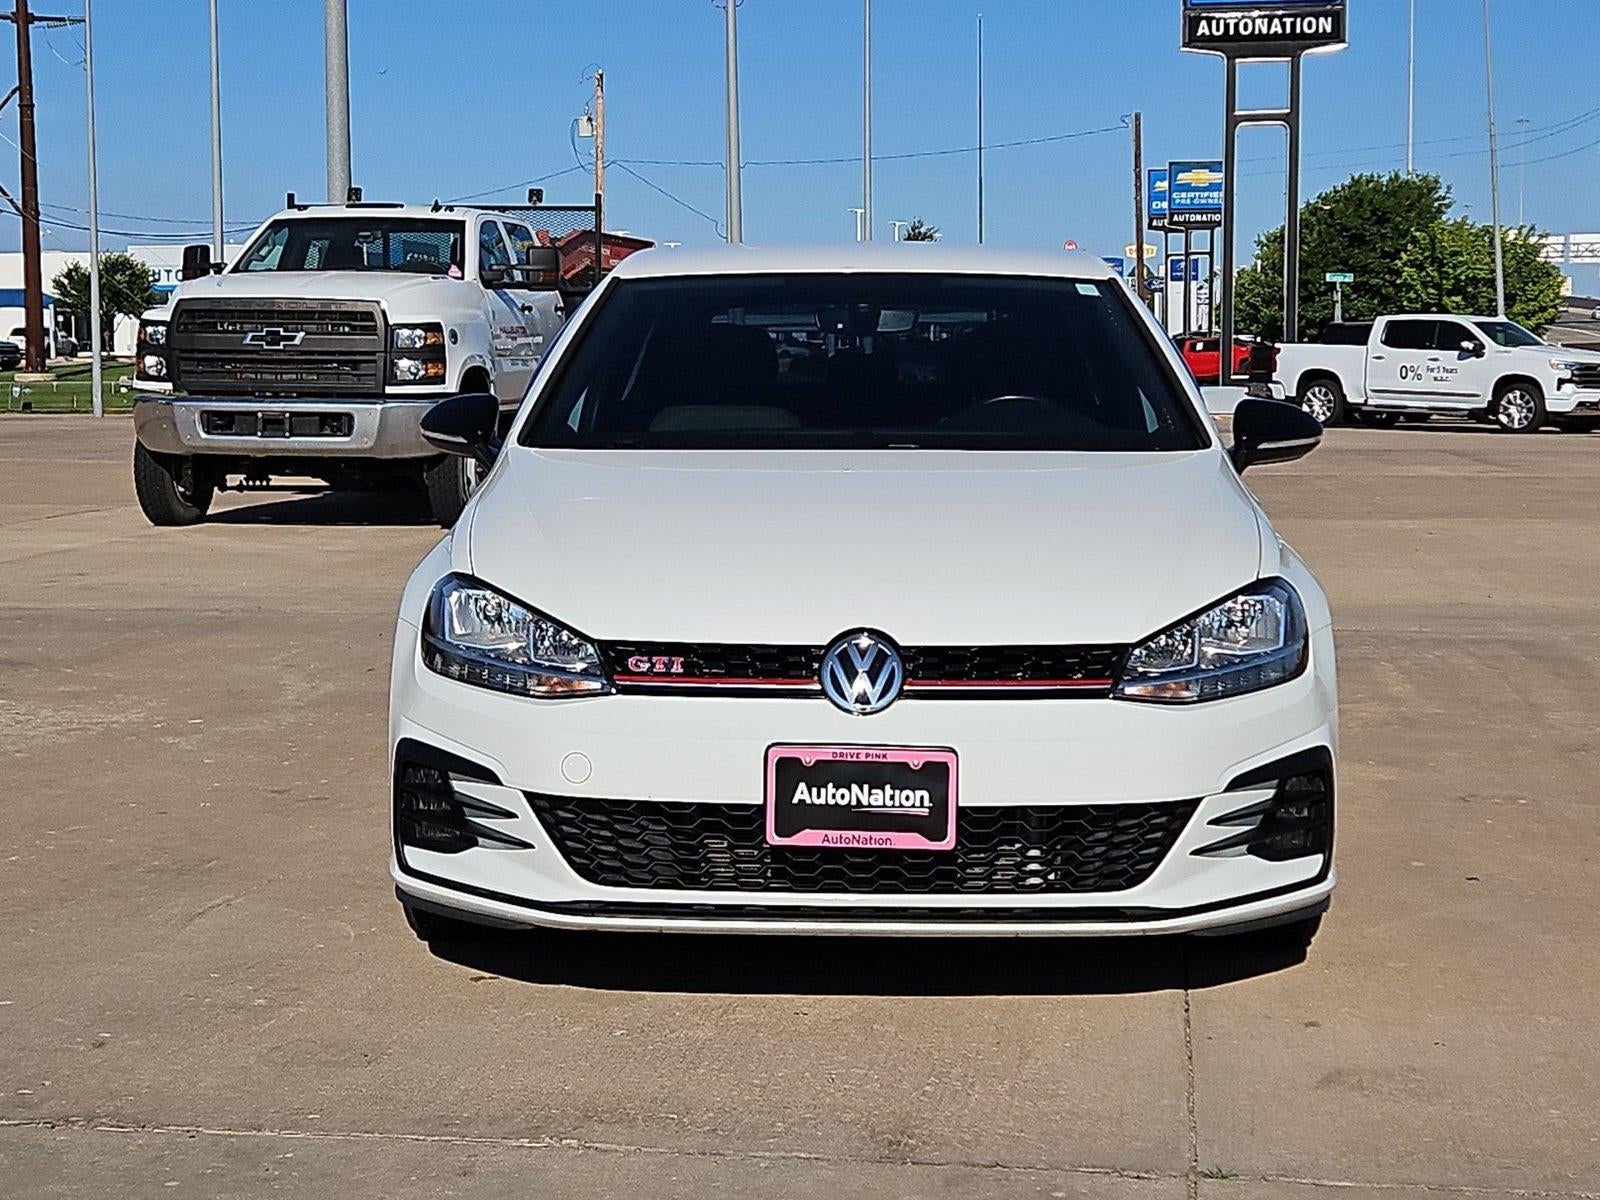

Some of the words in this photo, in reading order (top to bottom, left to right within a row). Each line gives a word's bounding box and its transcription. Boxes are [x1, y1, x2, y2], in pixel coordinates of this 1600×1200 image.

[1197, 17, 1333, 36] AUTONATION
[1172, 213, 1222, 222] AUTONATIO
[1399, 365, 1423, 381] 0%
[628, 655, 685, 673] GTI
[831, 751, 861, 759] DRIVE
[864, 752, 888, 760] PINK
[791, 782, 932, 807] AutoNation
